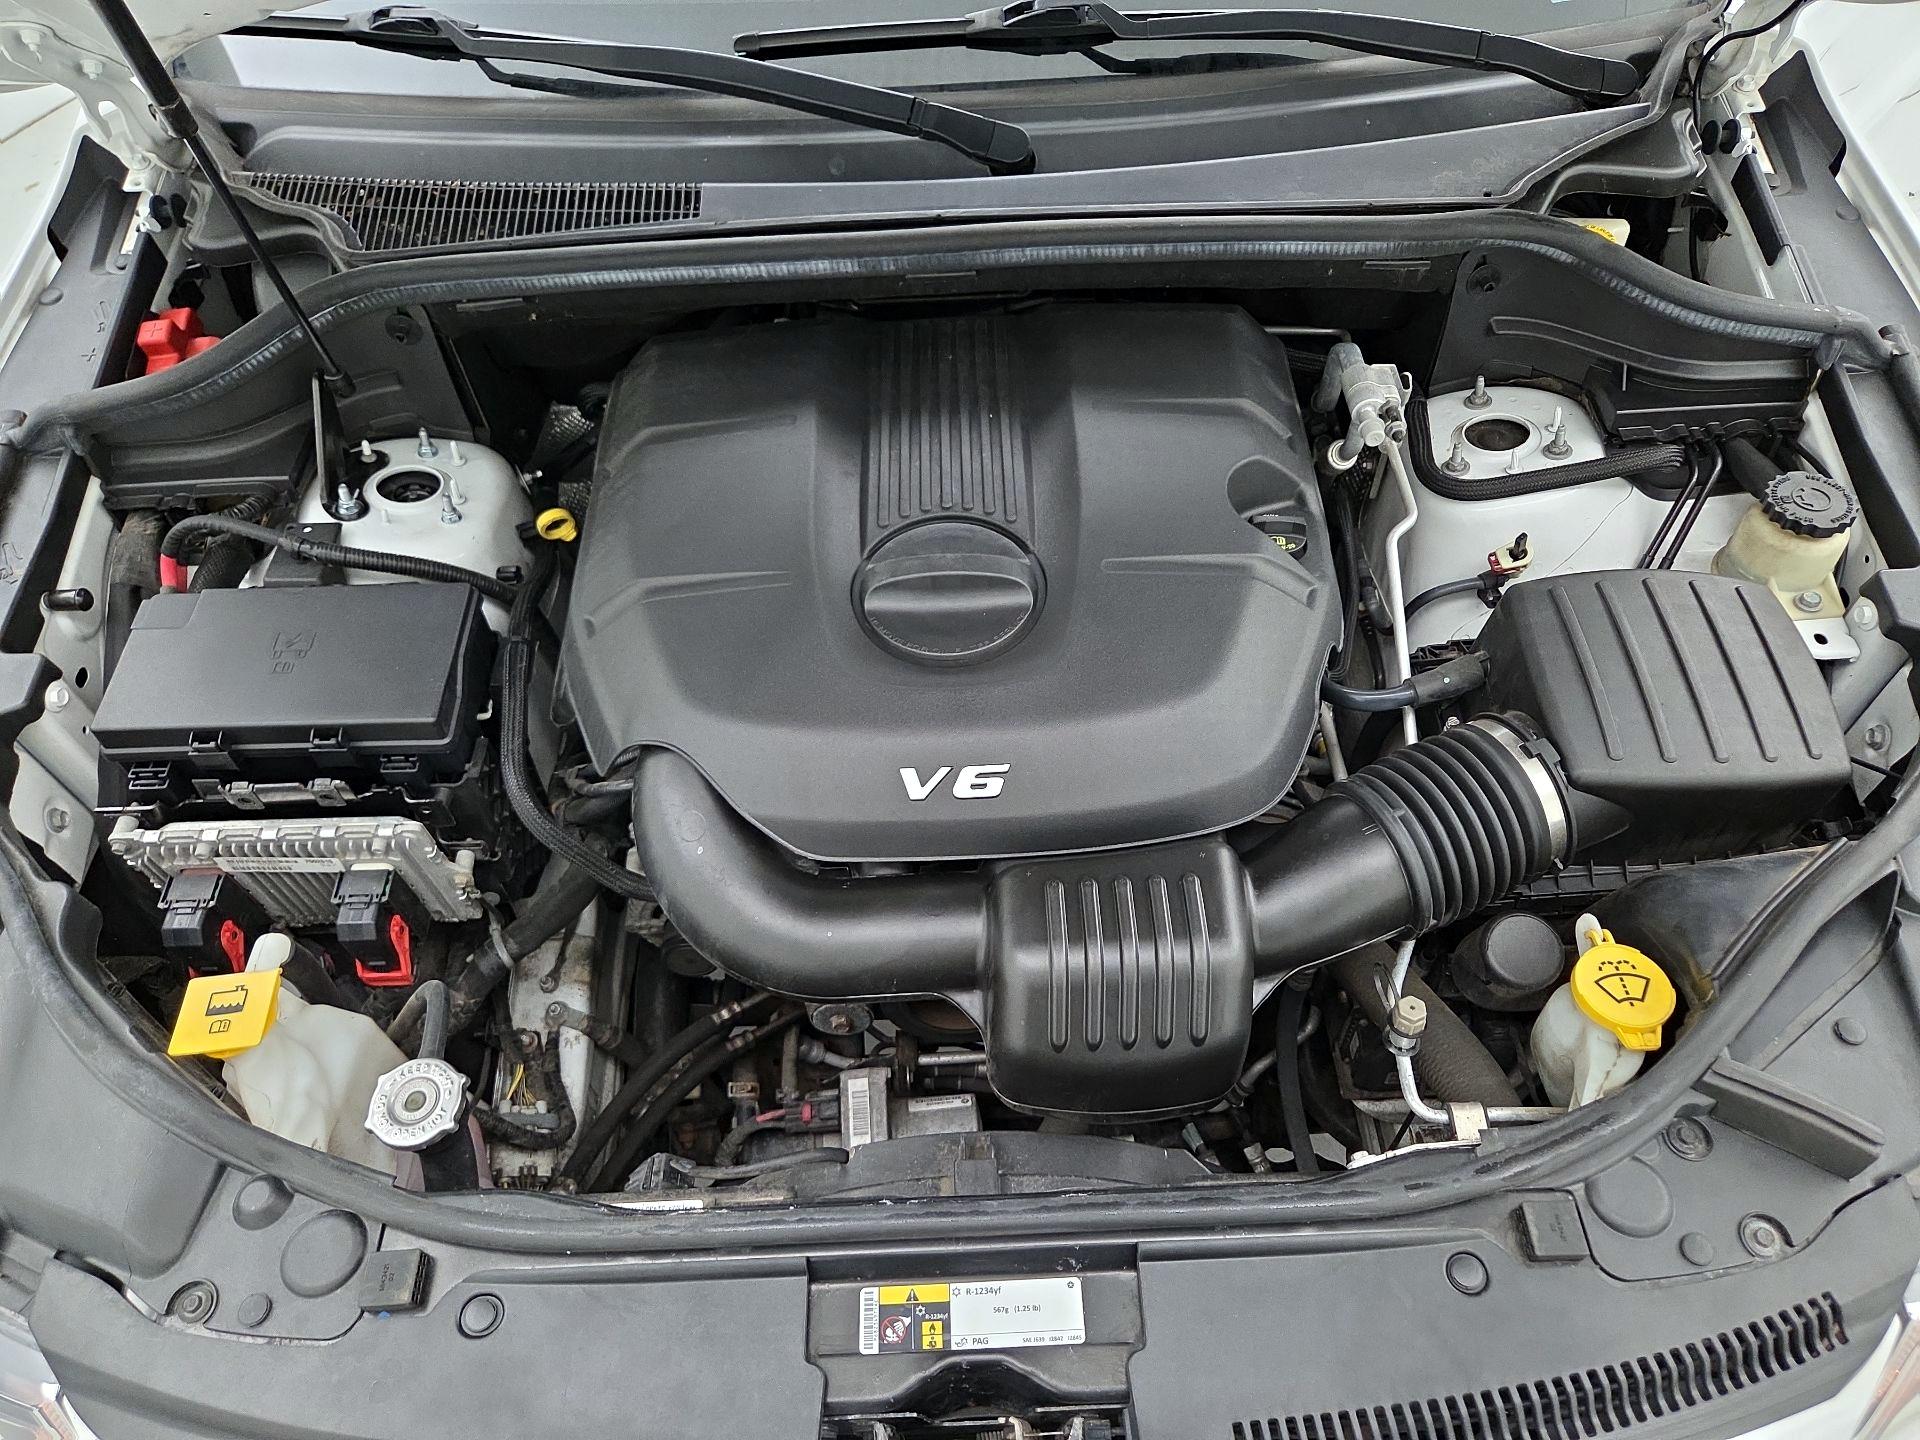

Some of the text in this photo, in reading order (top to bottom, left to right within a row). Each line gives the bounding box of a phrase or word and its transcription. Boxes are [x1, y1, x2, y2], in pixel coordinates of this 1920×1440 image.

[899, 763, 1012, 801] V6
[966, 1286, 1002, 1296] R-1234yf
[993, 1304, 1041, 1314] 567g (1.25 lb)
[972, 1336, 989, 1346] PAG
